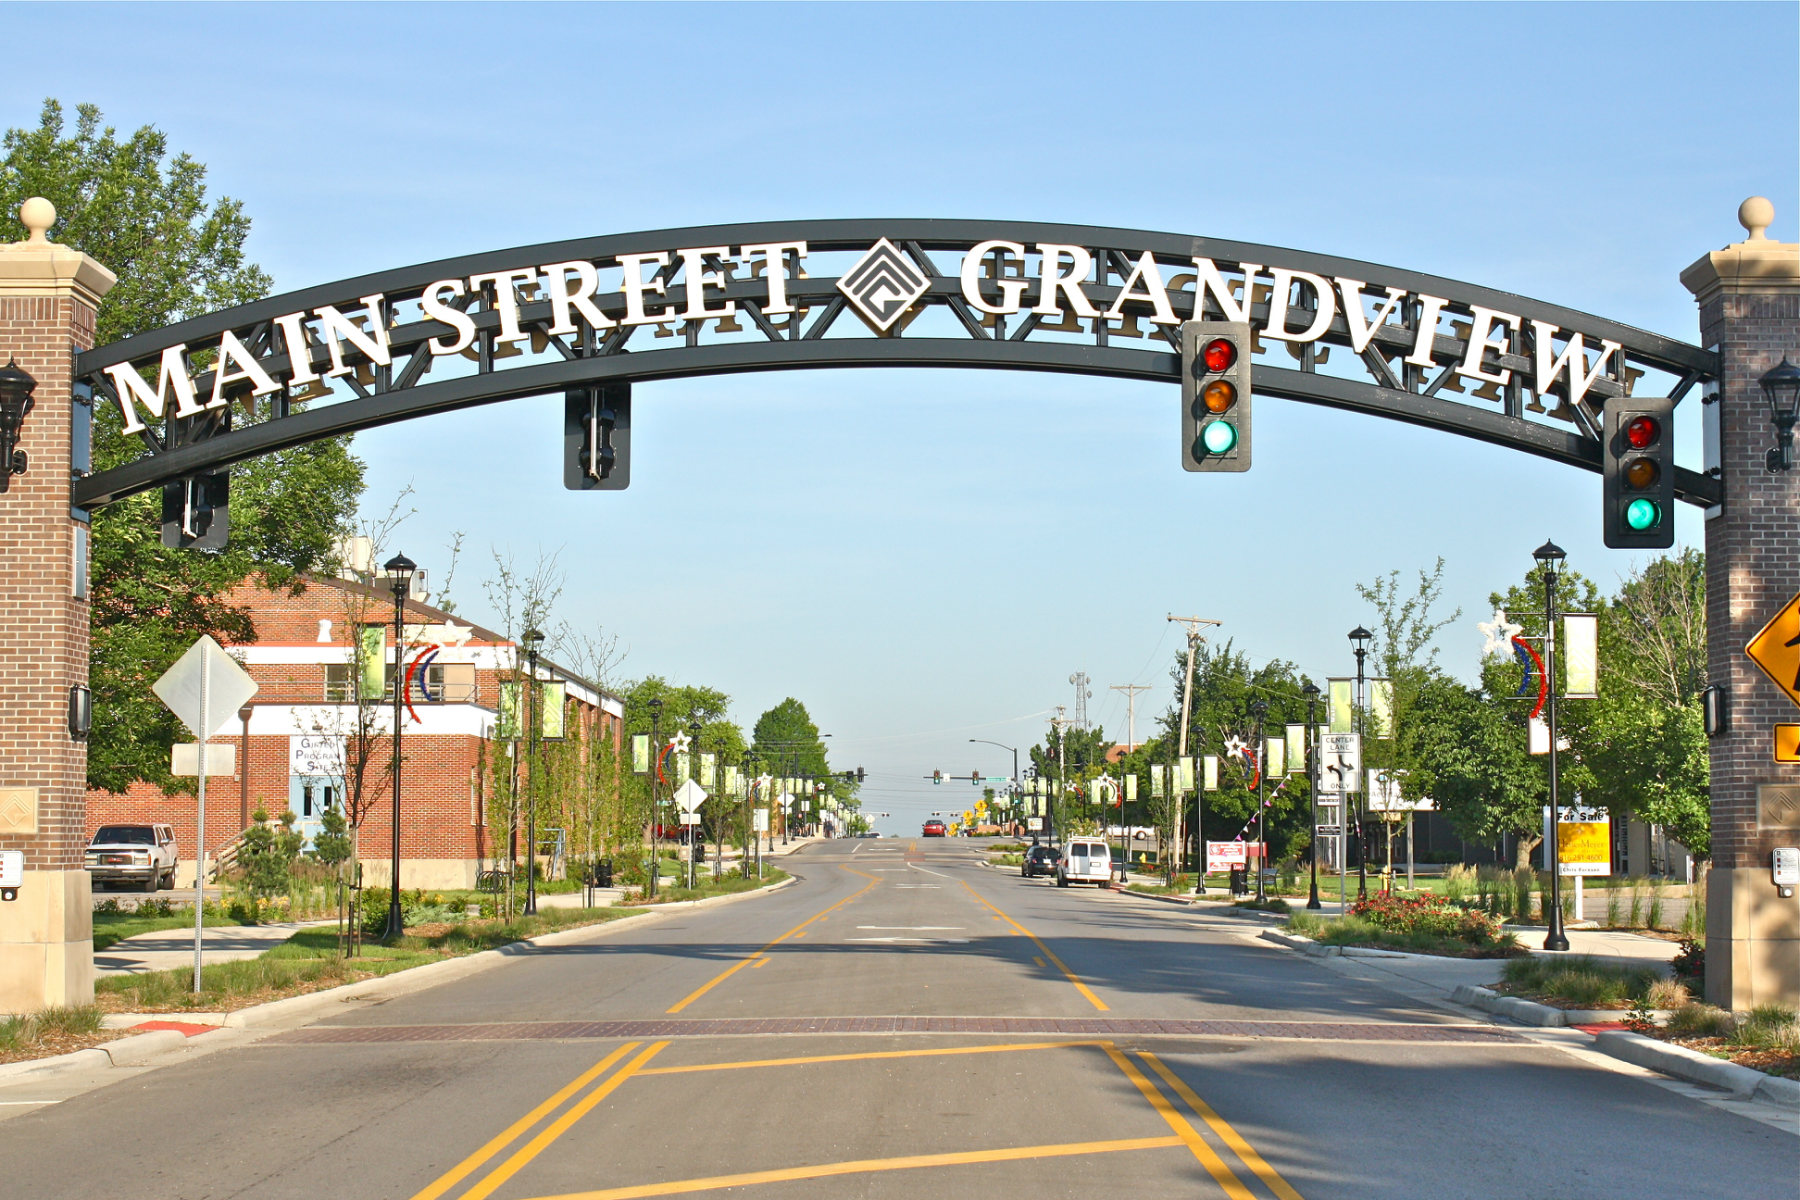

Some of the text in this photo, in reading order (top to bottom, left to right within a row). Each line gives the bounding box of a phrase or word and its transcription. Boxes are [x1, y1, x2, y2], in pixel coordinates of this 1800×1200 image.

[103, 239, 1622, 436] MAIN STREET GRANDVIEW
[306, 760, 328, 772] STE
[1557, 812, 1604, 821] For Sale
